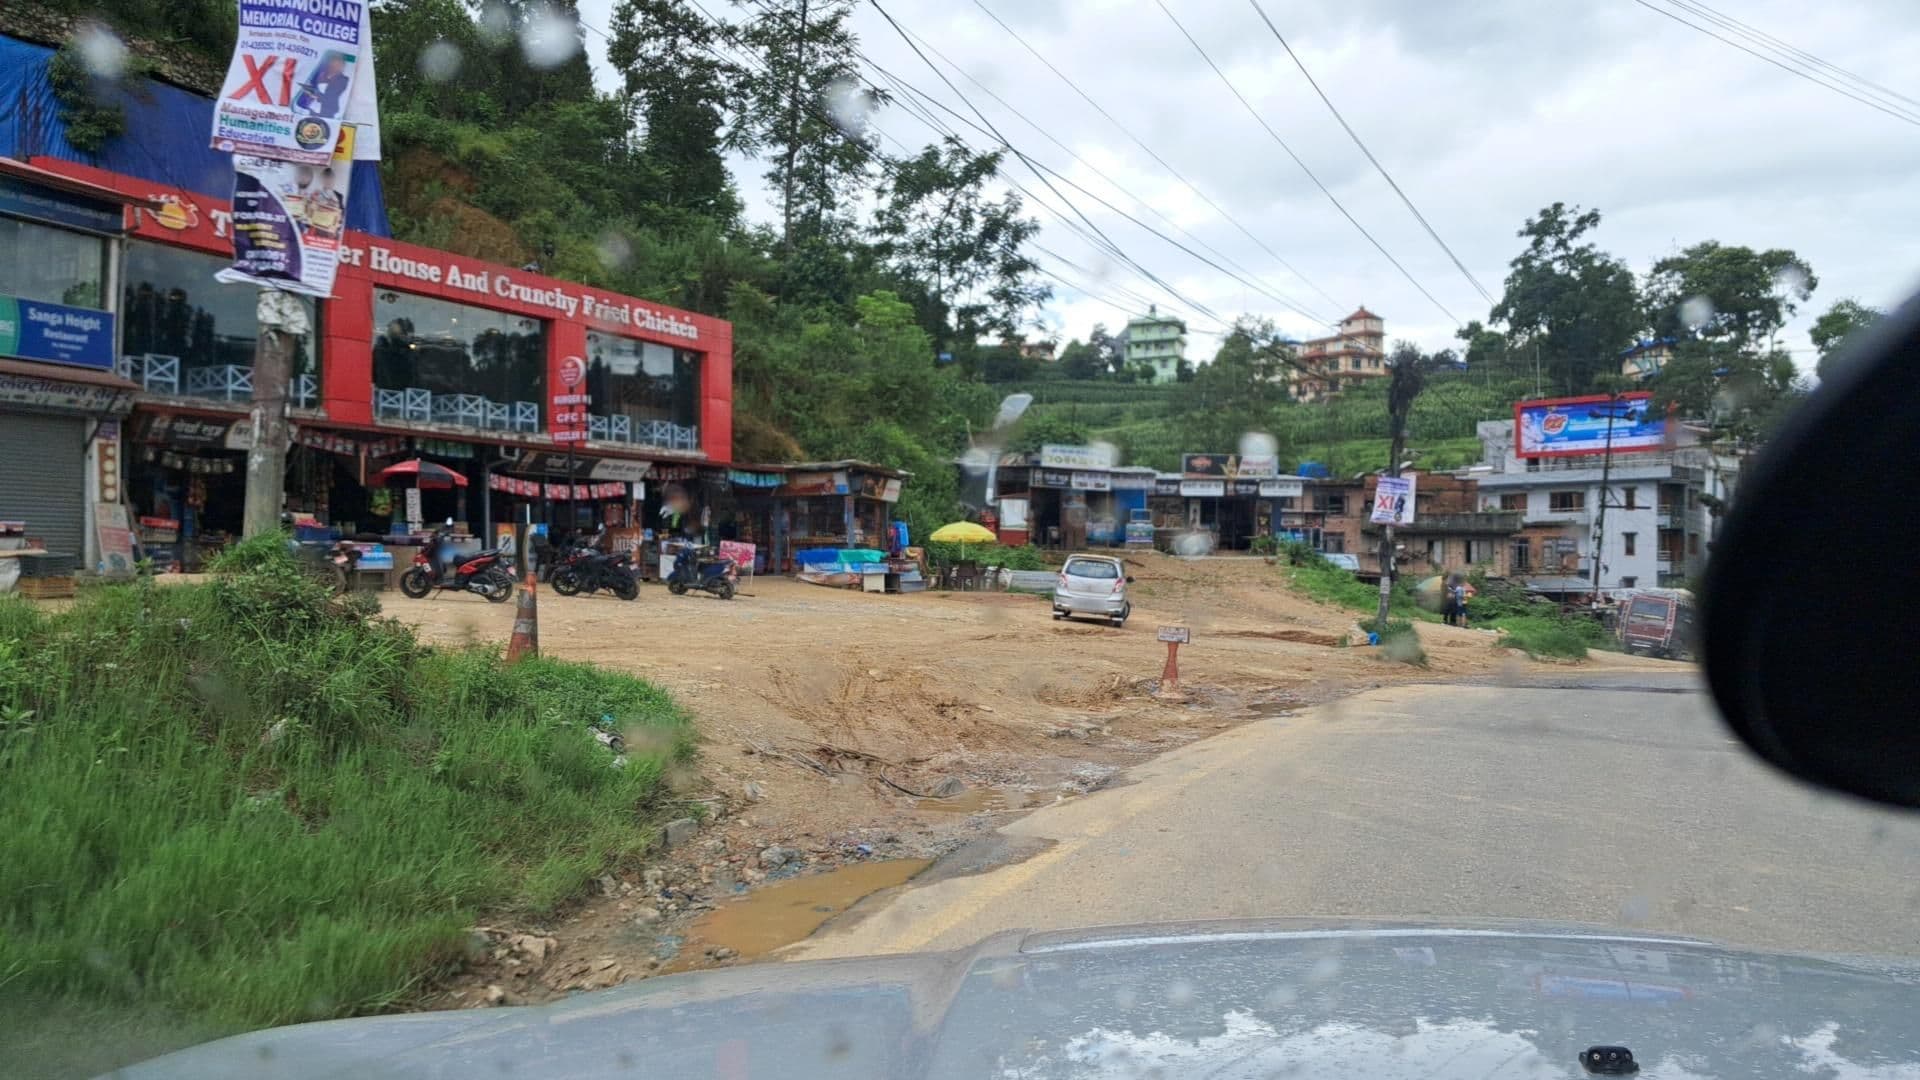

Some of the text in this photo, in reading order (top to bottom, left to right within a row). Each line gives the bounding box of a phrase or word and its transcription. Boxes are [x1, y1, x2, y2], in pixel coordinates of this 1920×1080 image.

[242, 10, 300, 29] MEMORIAL
[302, 18, 358, 41] COLLEGE
[227, 54, 298, 107] XI
[220, 102, 294, 123] Management
[218, 126, 275, 144] Education
[219, 114, 291, 136] Humanities
[369, 246, 442, 283] House
[446, 265, 489, 295] And
[494, 279, 579, 318] Crunchy
[582, 295, 631, 325] Fried
[632, 307, 699, 341] Chicken
[28, 307, 62, 327] Sanga
[43, 327, 88, 344] Restaurant
[1377, 494, 1395, 511] XI
